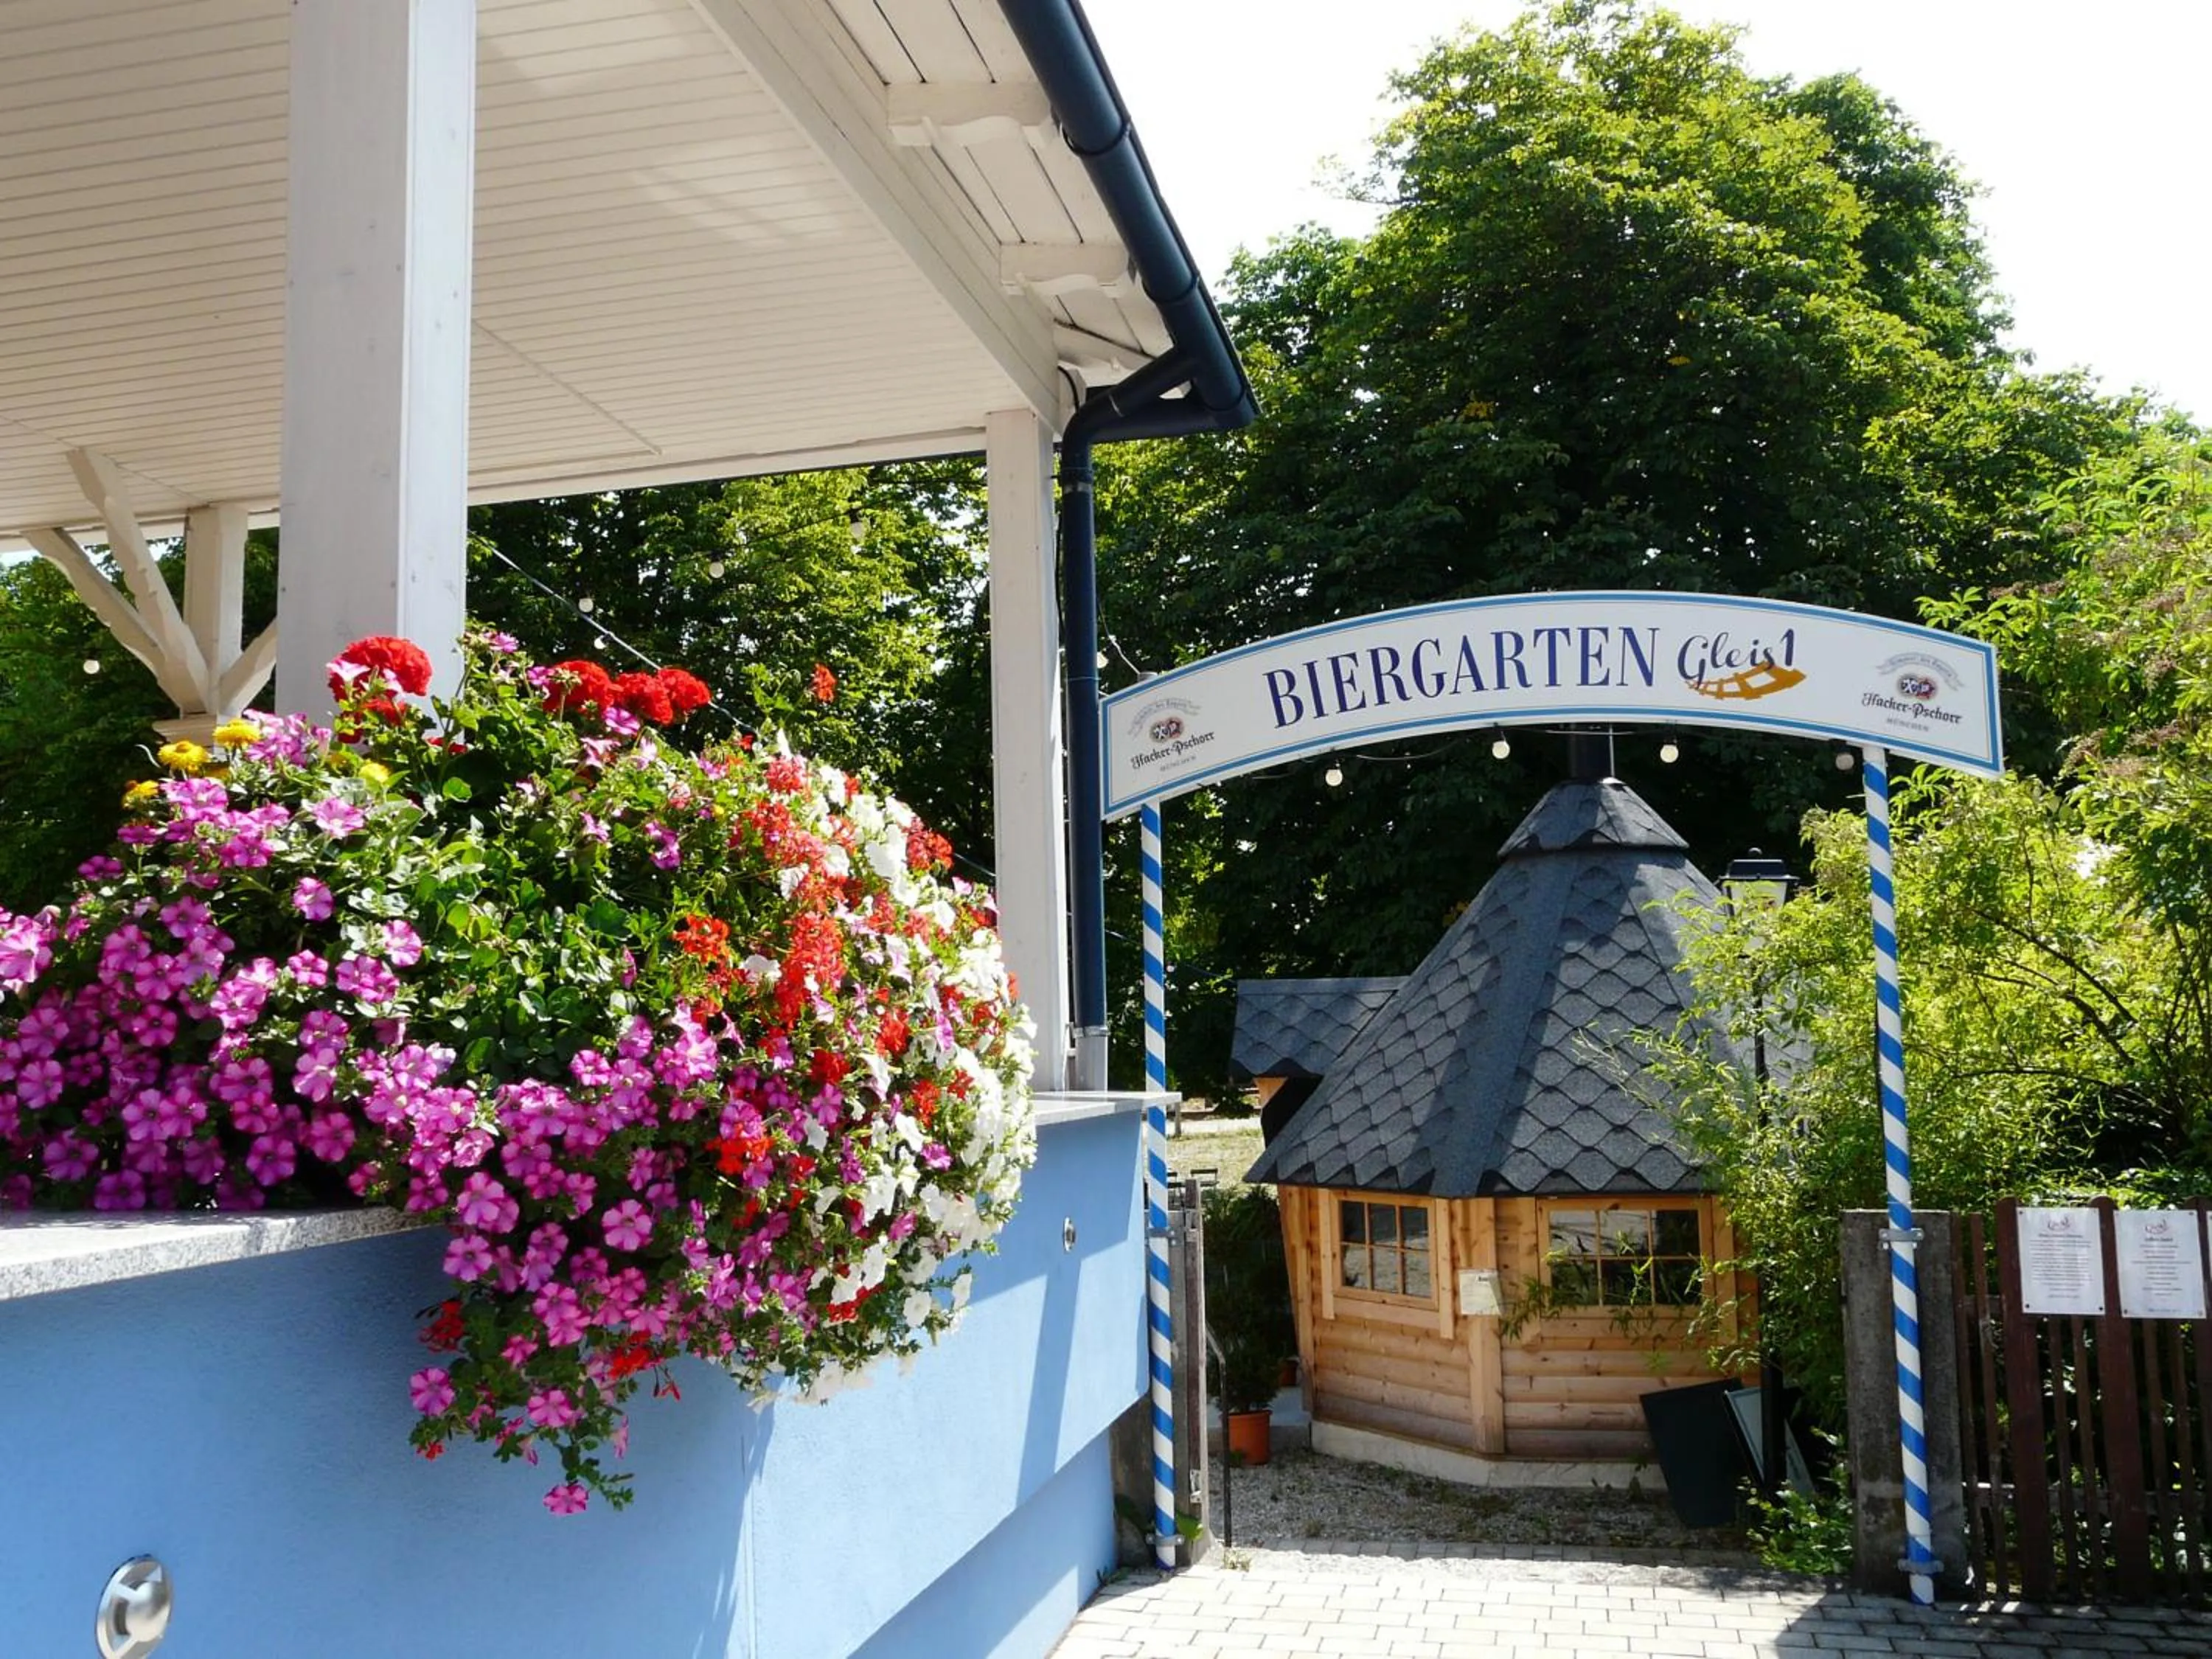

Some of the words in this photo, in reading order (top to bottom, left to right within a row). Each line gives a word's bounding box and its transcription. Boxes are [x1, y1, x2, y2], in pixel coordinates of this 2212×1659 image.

[1262, 626, 1659, 728] BIERGARTEN
[1861, 692, 1962, 724] Hacker-Pschorr
[1130, 731, 1215, 770] Hacker-Pschorr
